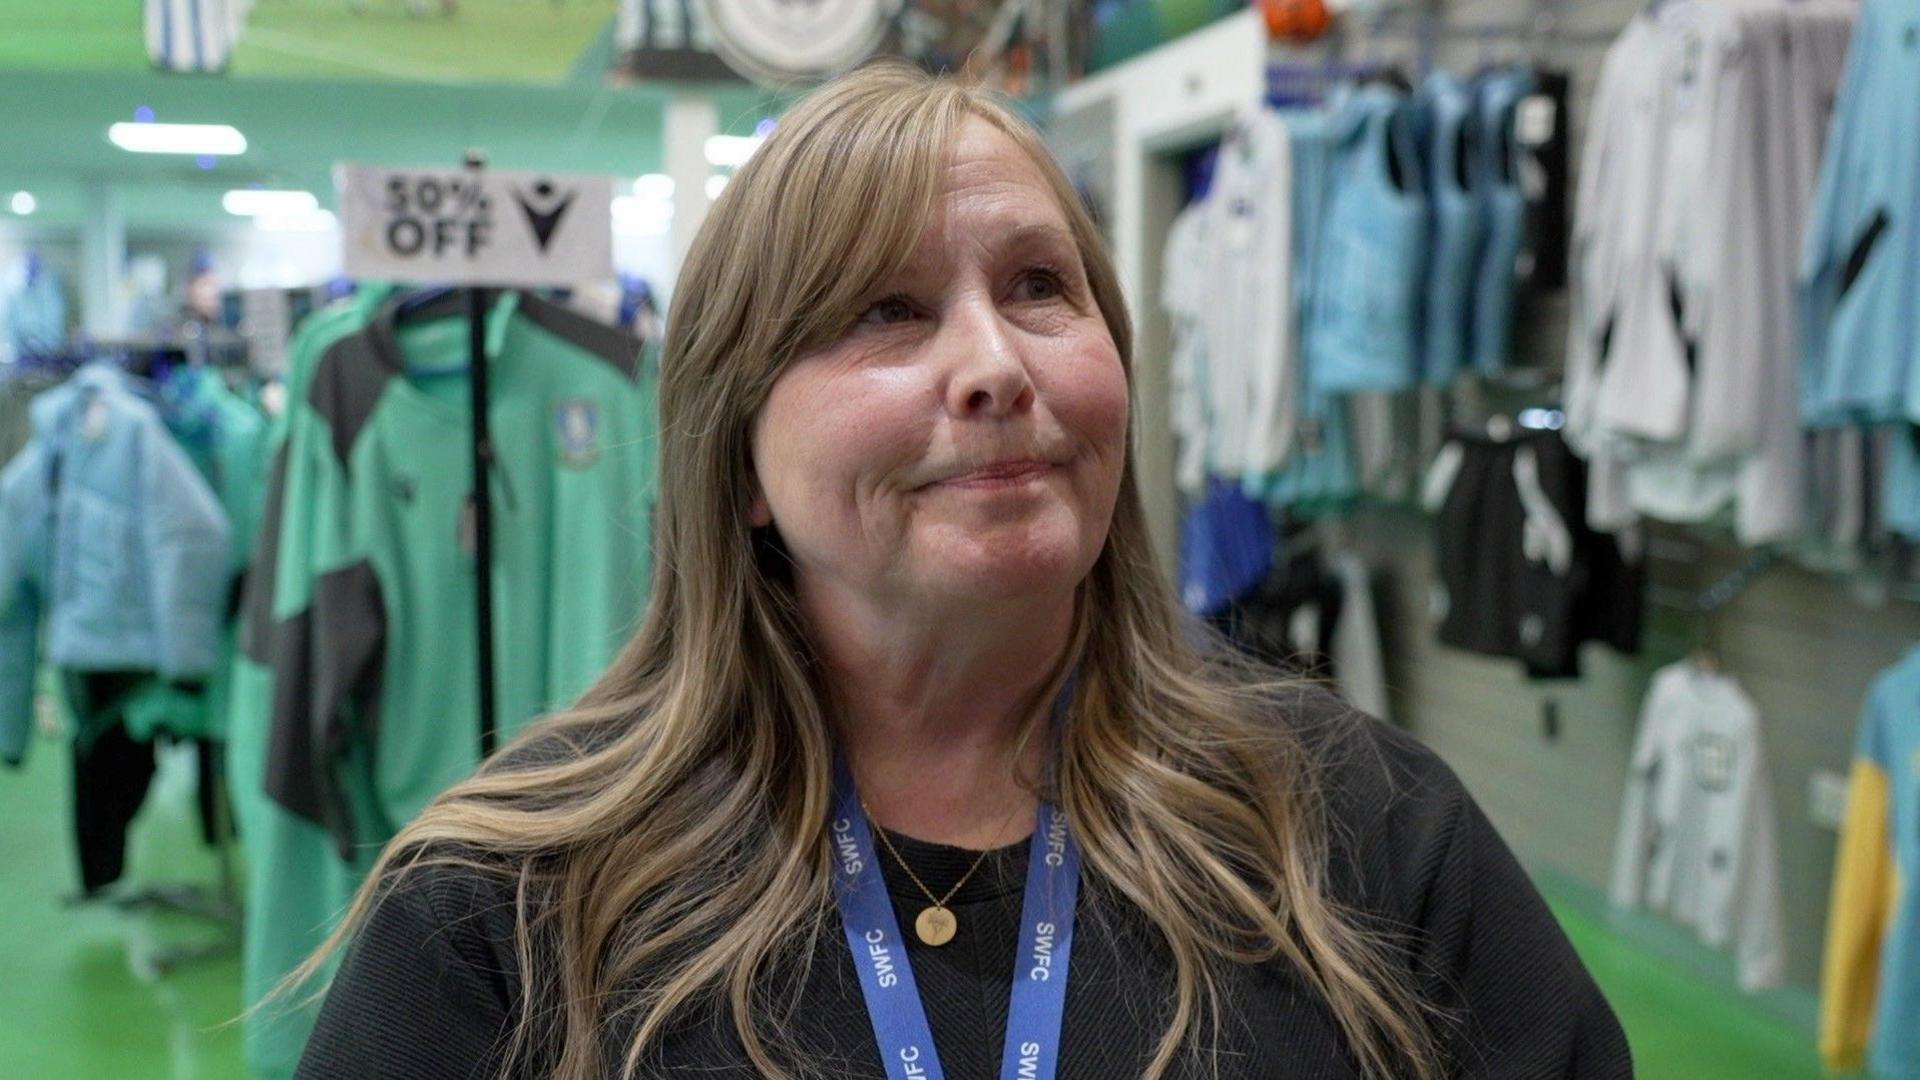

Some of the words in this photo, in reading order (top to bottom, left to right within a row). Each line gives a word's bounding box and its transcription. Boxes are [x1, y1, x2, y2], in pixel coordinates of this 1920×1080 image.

[386, 177, 490, 213] 50%
[386, 216, 494, 258] OFF
[833, 818, 862, 875] SWFC
[1046, 811, 1067, 867] SWFC
[865, 928, 897, 988] SWFC
[1030, 922, 1055, 981] SWFC
[900, 1046, 927, 1080] FC
[1017, 1041, 1040, 1080] SW
